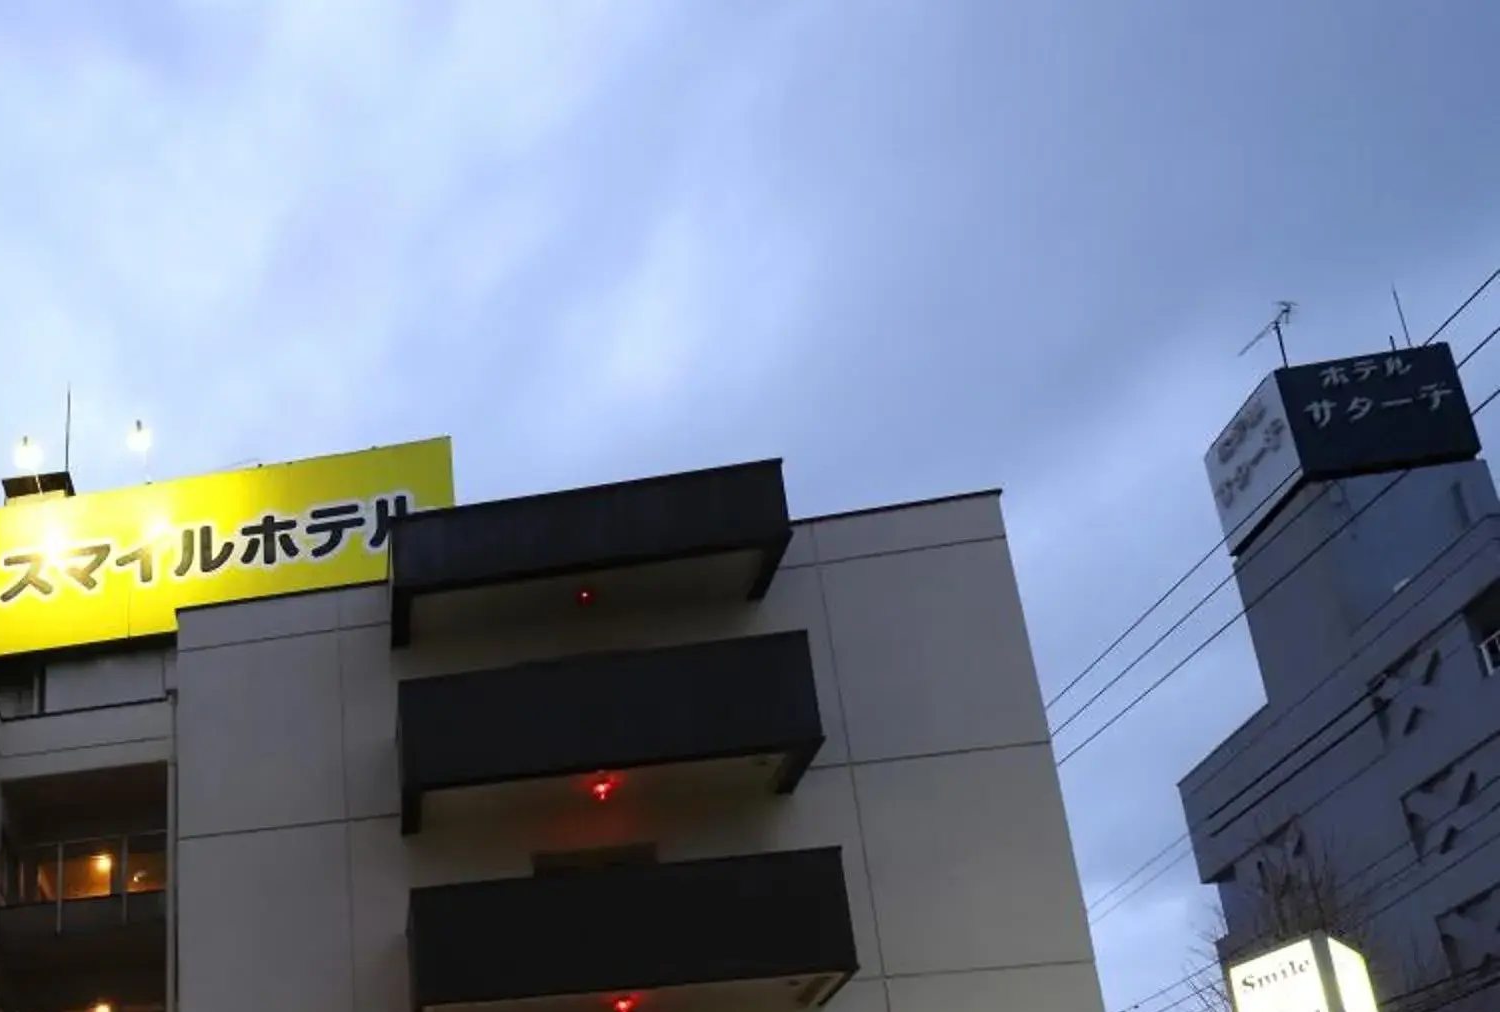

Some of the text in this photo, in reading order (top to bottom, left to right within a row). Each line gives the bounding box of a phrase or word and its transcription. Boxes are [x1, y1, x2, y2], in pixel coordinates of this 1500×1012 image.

[1319, 356, 1413, 390] ホテル
[0, 494, 415, 603] スマイルホテル
[1240, 957, 1312, 993] Smile
